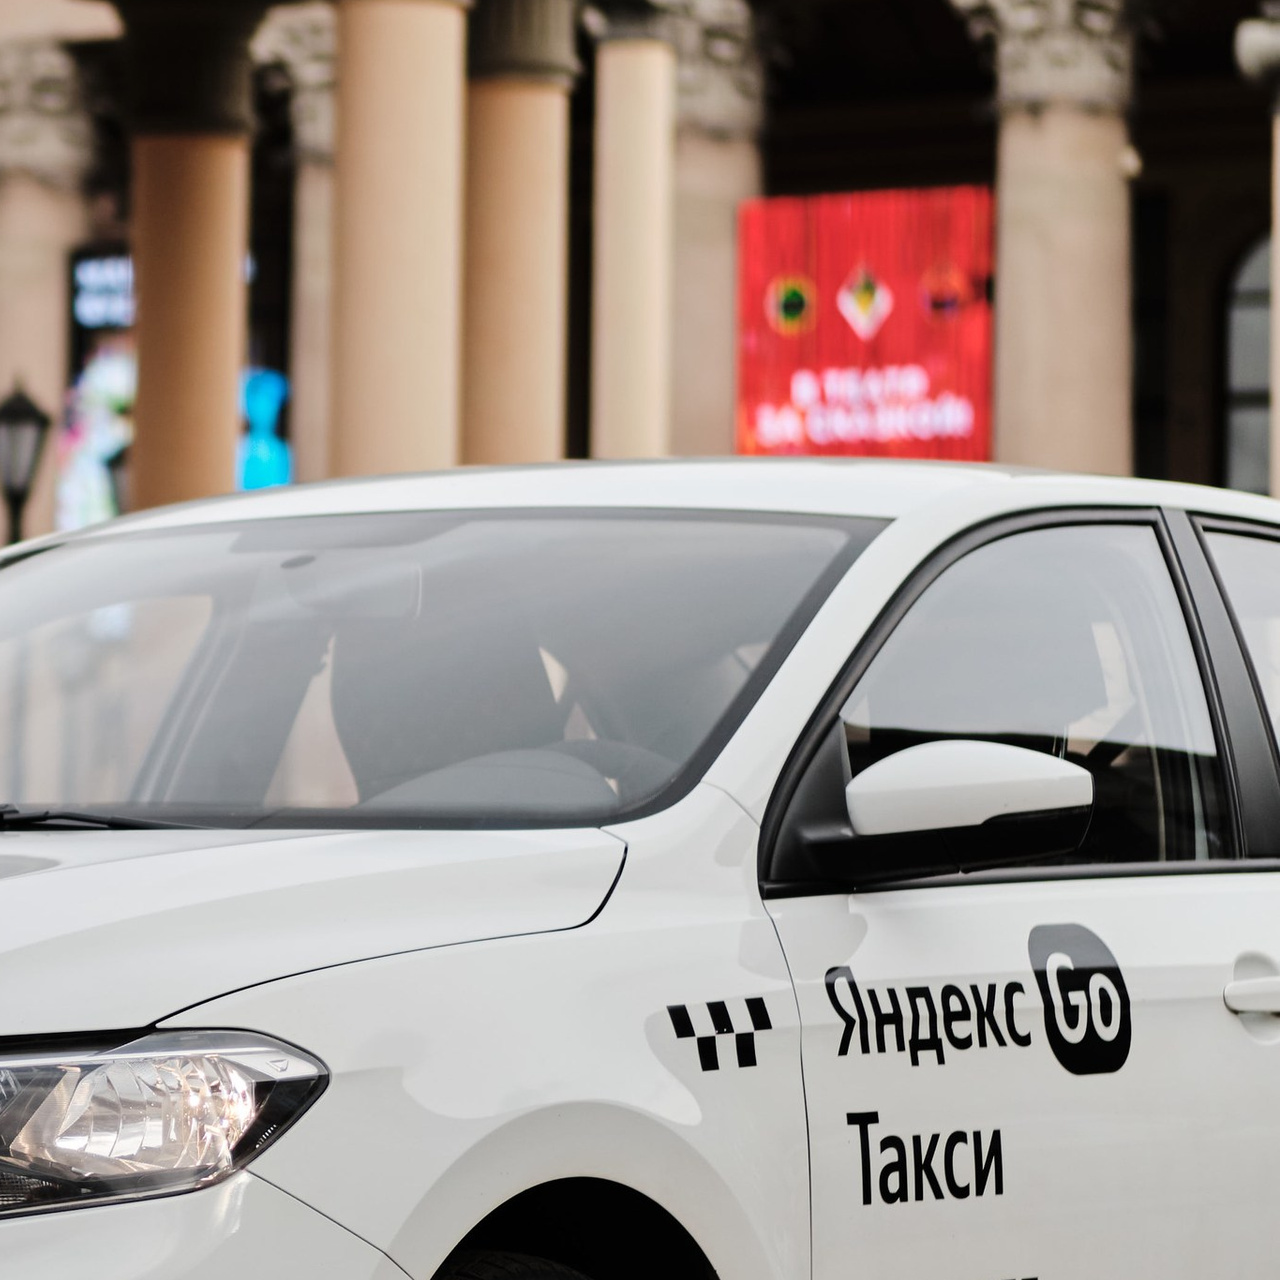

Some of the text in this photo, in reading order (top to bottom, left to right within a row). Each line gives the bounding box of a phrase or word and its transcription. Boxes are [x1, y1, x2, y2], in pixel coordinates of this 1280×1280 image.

[824, 950, 1123, 1067] Яндекс Go
[846, 1110, 1005, 1207] Такси
